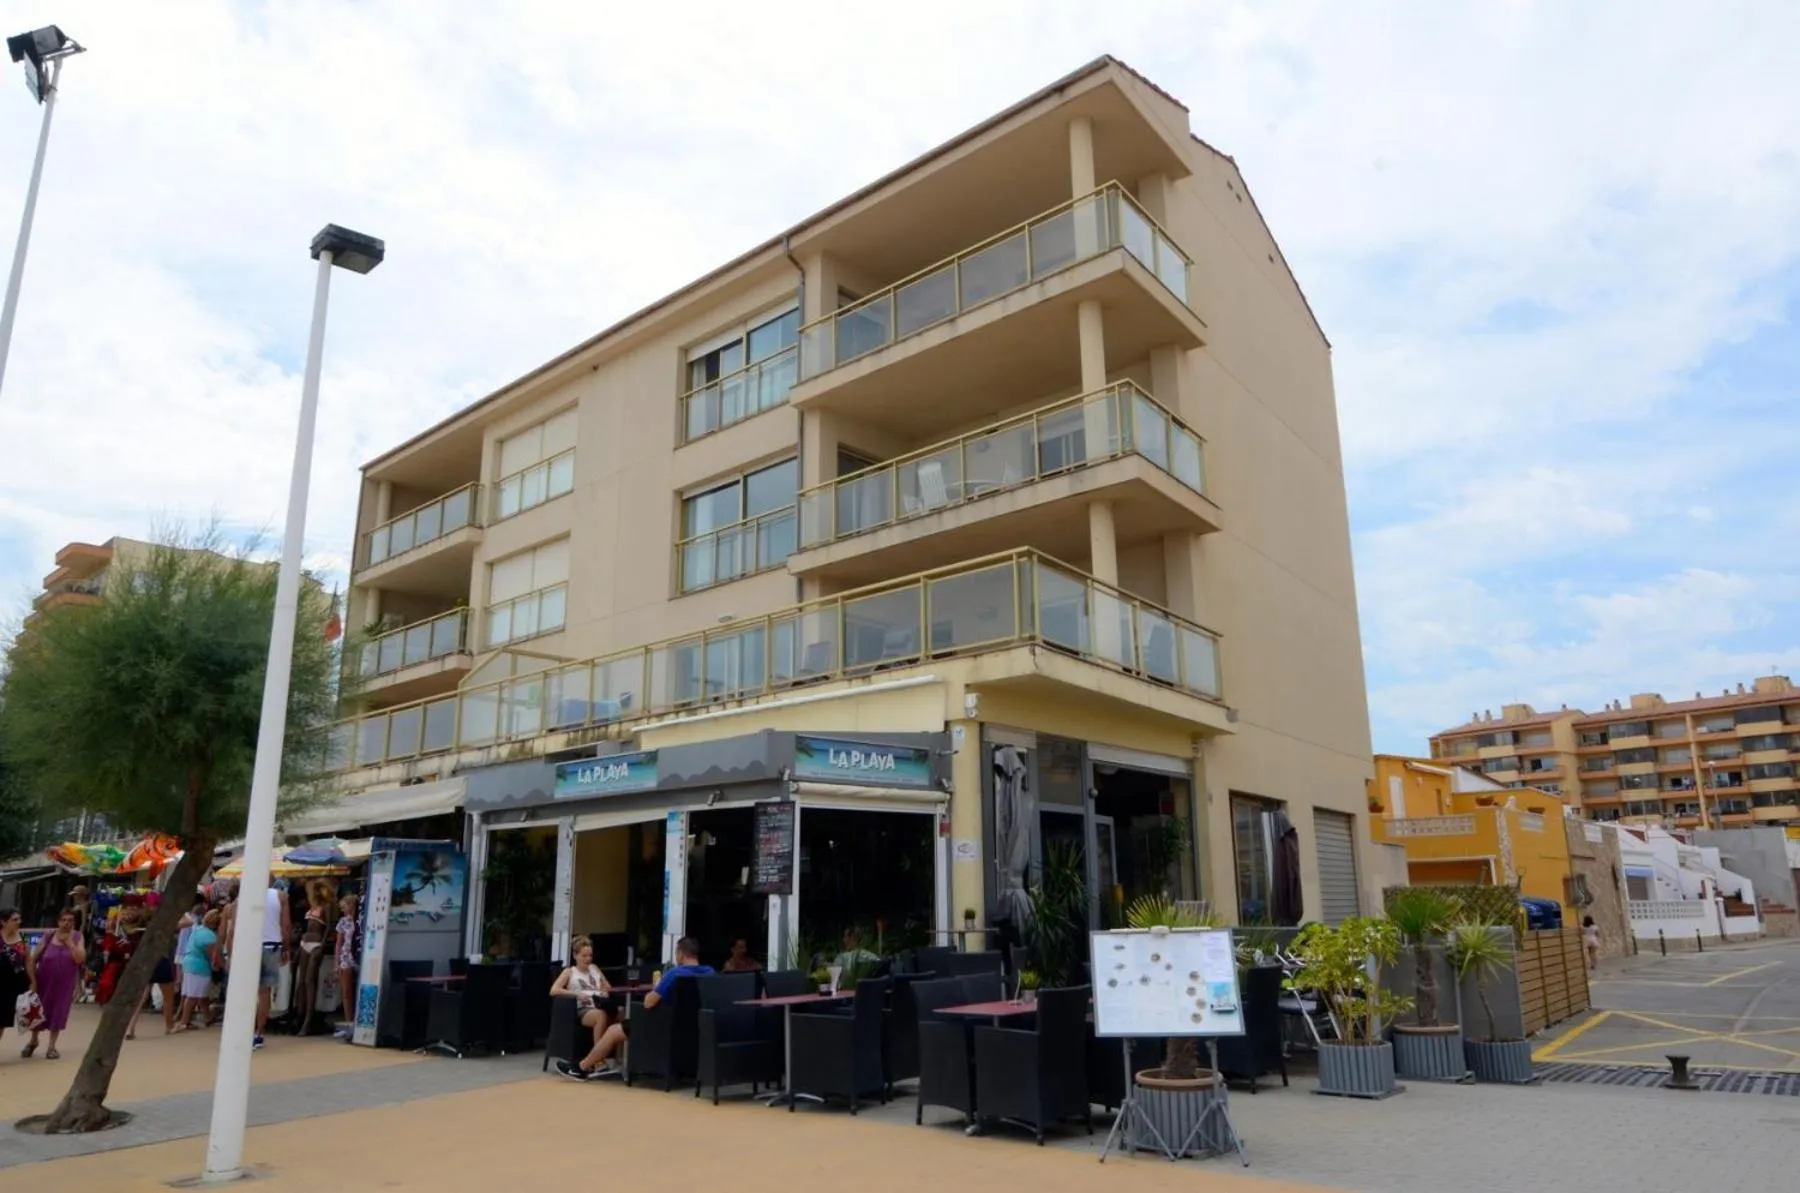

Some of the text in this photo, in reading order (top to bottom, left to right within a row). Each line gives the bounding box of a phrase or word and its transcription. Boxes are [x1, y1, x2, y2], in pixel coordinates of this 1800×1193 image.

[829, 748, 895, 770] LA PLAYA
[578, 762, 628, 784] LA PLAYA
